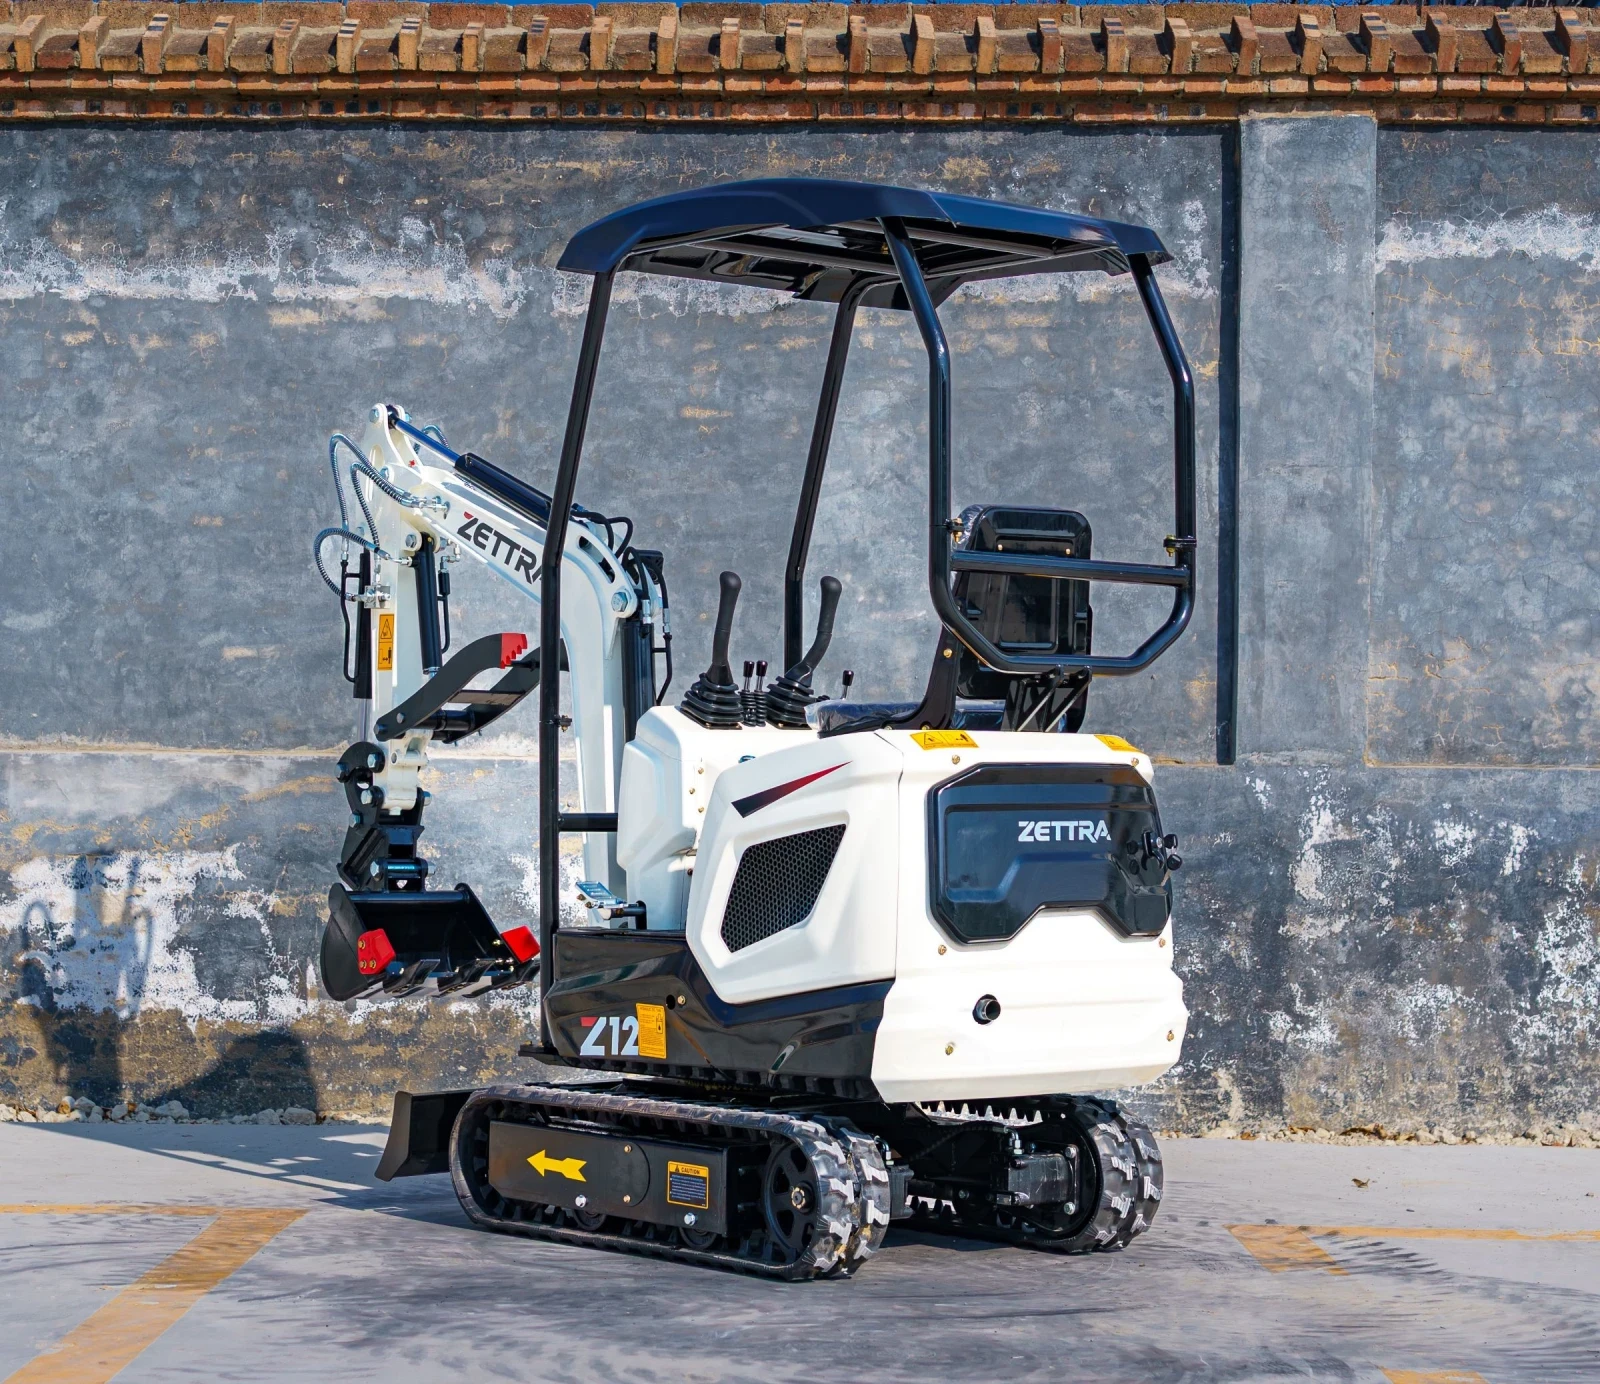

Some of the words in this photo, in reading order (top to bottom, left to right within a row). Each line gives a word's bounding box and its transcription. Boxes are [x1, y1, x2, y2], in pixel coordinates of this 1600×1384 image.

[1018, 820, 1112, 843] ZETTRA
[580, 1016, 639, 1056] Z12
[681, 1167, 700, 1175] CAUTION
